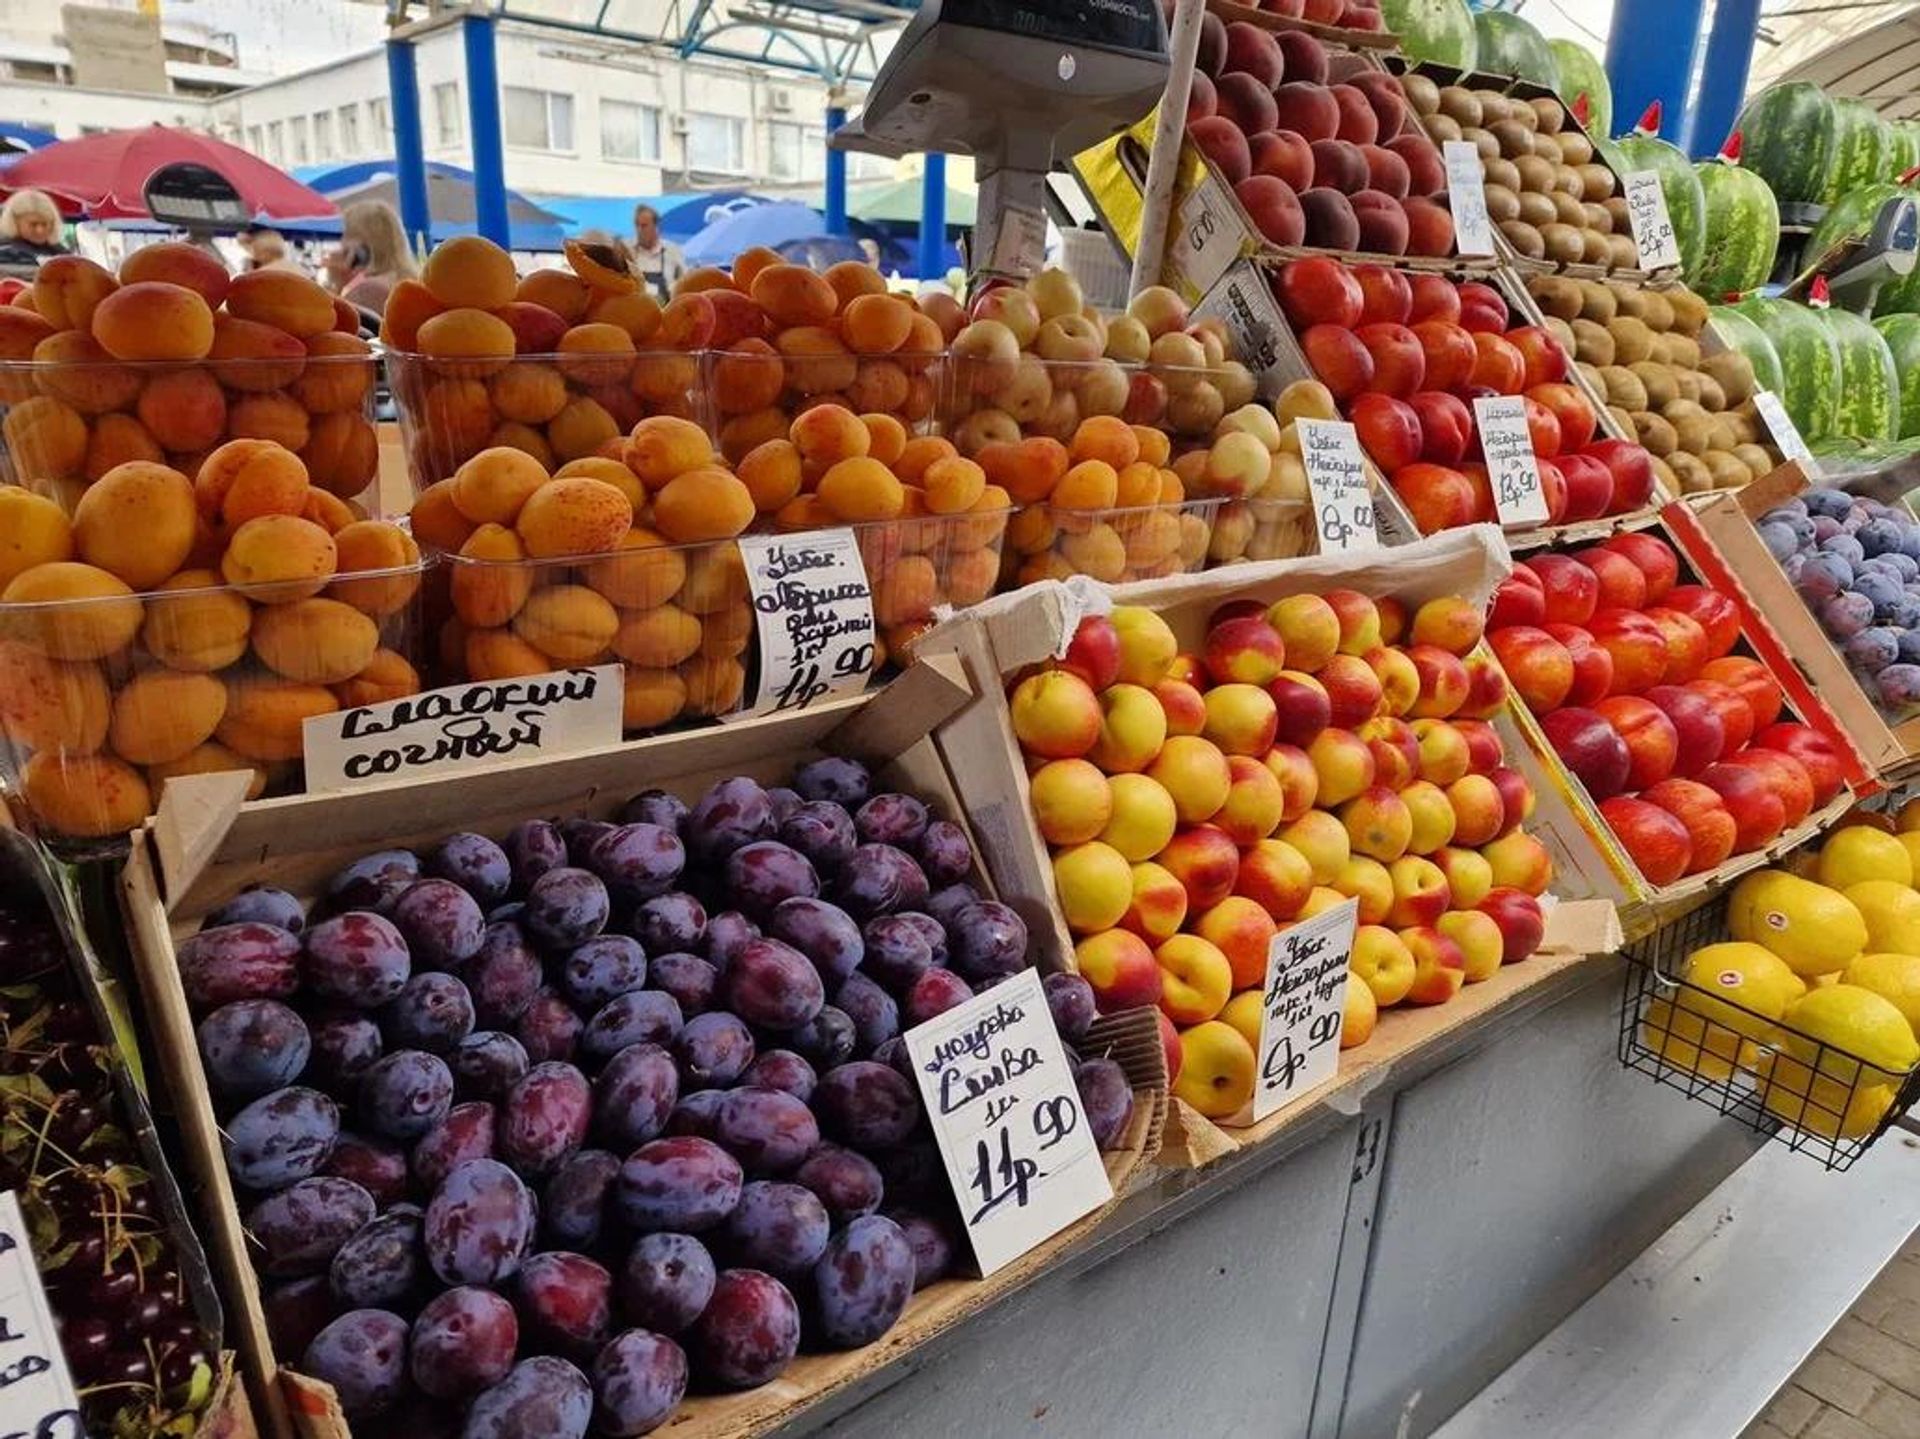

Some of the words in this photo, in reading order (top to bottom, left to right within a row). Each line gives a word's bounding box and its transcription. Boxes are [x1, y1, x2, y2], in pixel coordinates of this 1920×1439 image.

[830, 643, 875, 678] 90
[1308, 1010, 1340, 1051] 90
[1032, 1096, 1076, 1151] 90
